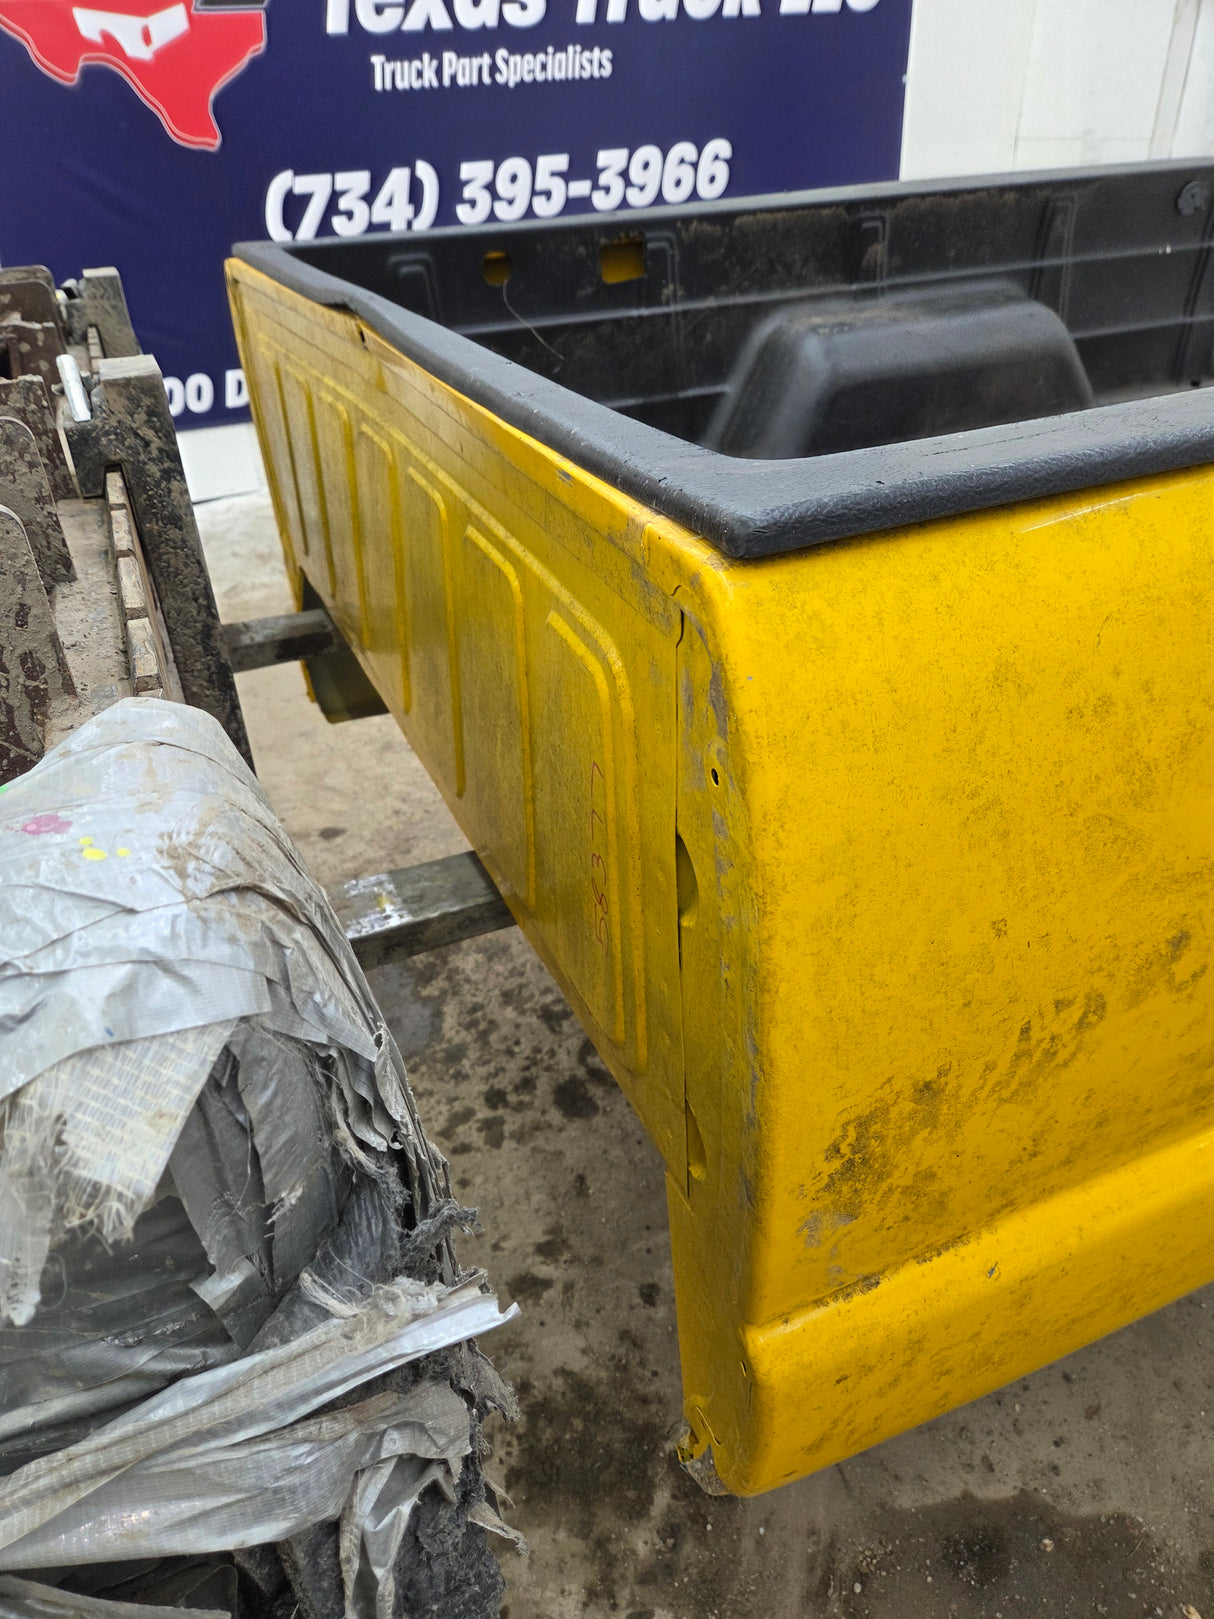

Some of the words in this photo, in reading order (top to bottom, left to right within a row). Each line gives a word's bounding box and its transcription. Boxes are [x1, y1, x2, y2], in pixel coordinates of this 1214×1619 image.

[370, 53, 439, 92] Truck
[442, 50, 493, 88] Part
[494, 44, 614, 88] Specialists
[265, 159, 440, 242] (734)
[455, 138, 733, 226] 395-3966
